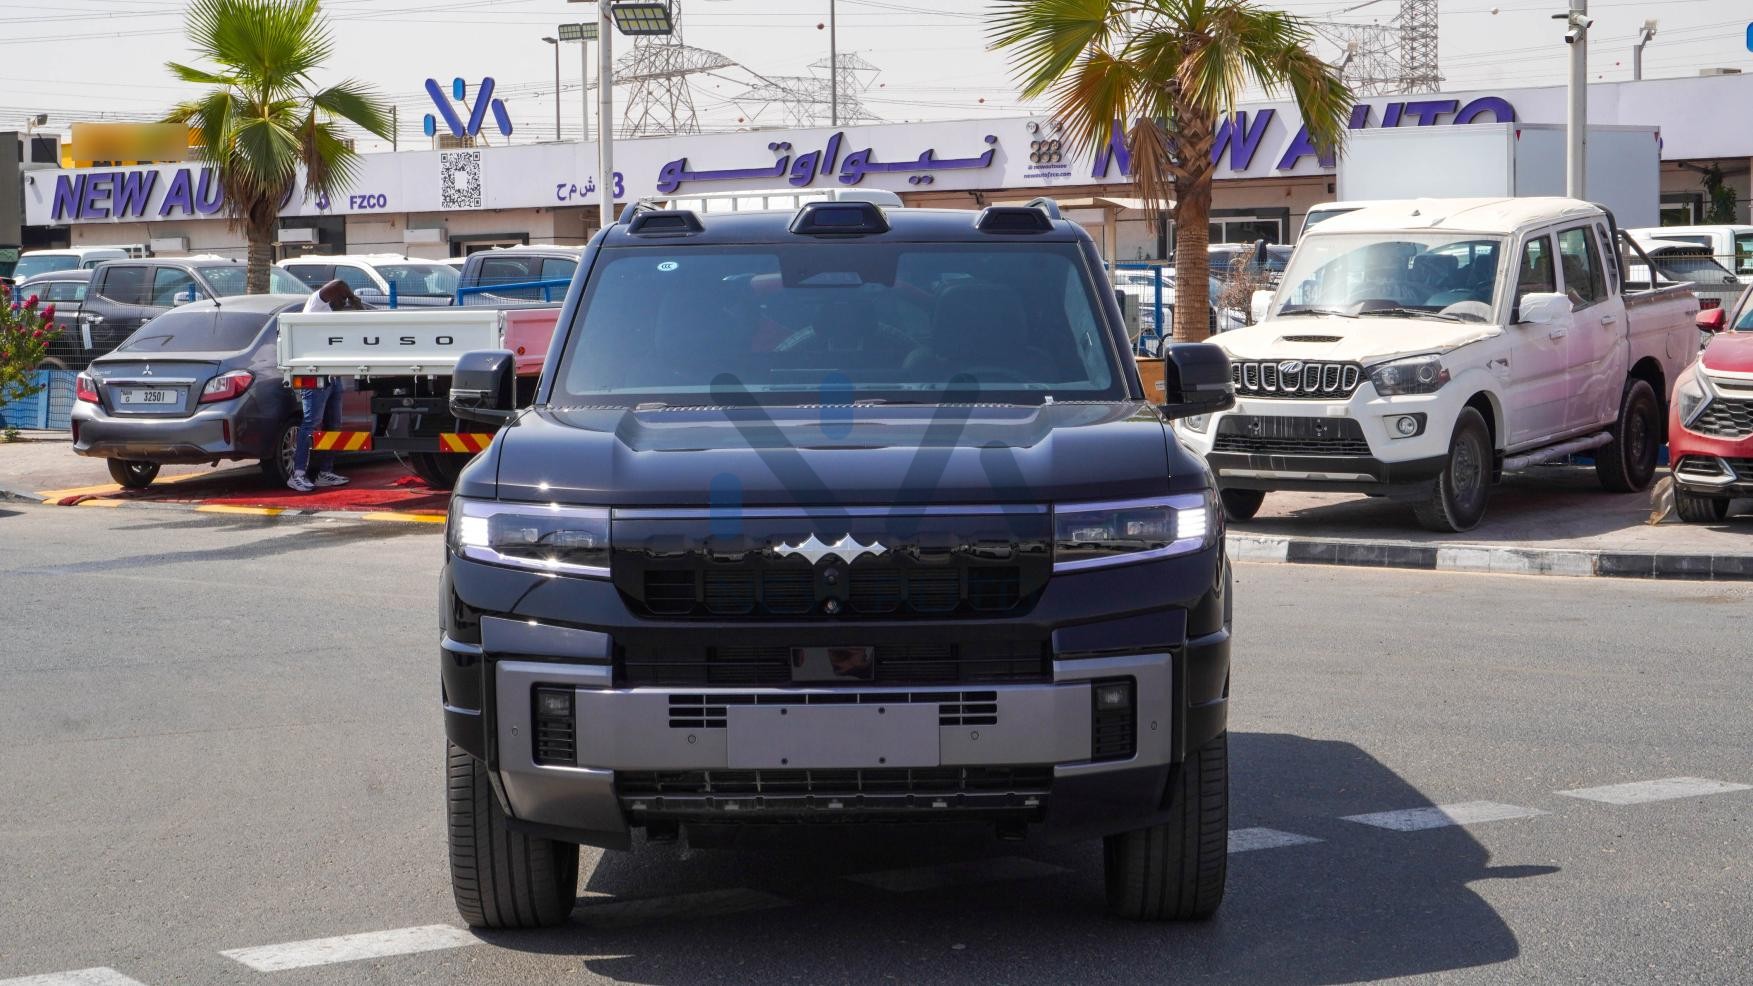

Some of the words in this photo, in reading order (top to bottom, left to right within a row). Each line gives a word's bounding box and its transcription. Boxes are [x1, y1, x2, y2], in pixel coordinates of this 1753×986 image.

[1091, 109, 1276, 177] NW
[51, 170, 159, 221] NEW
[158, 166, 296, 217] AU
[349, 193, 387, 210] FZCO
[612, 171, 625, 199] 3
[328, 335, 454, 346] FUSO
[143, 391, 165, 402] 32501
